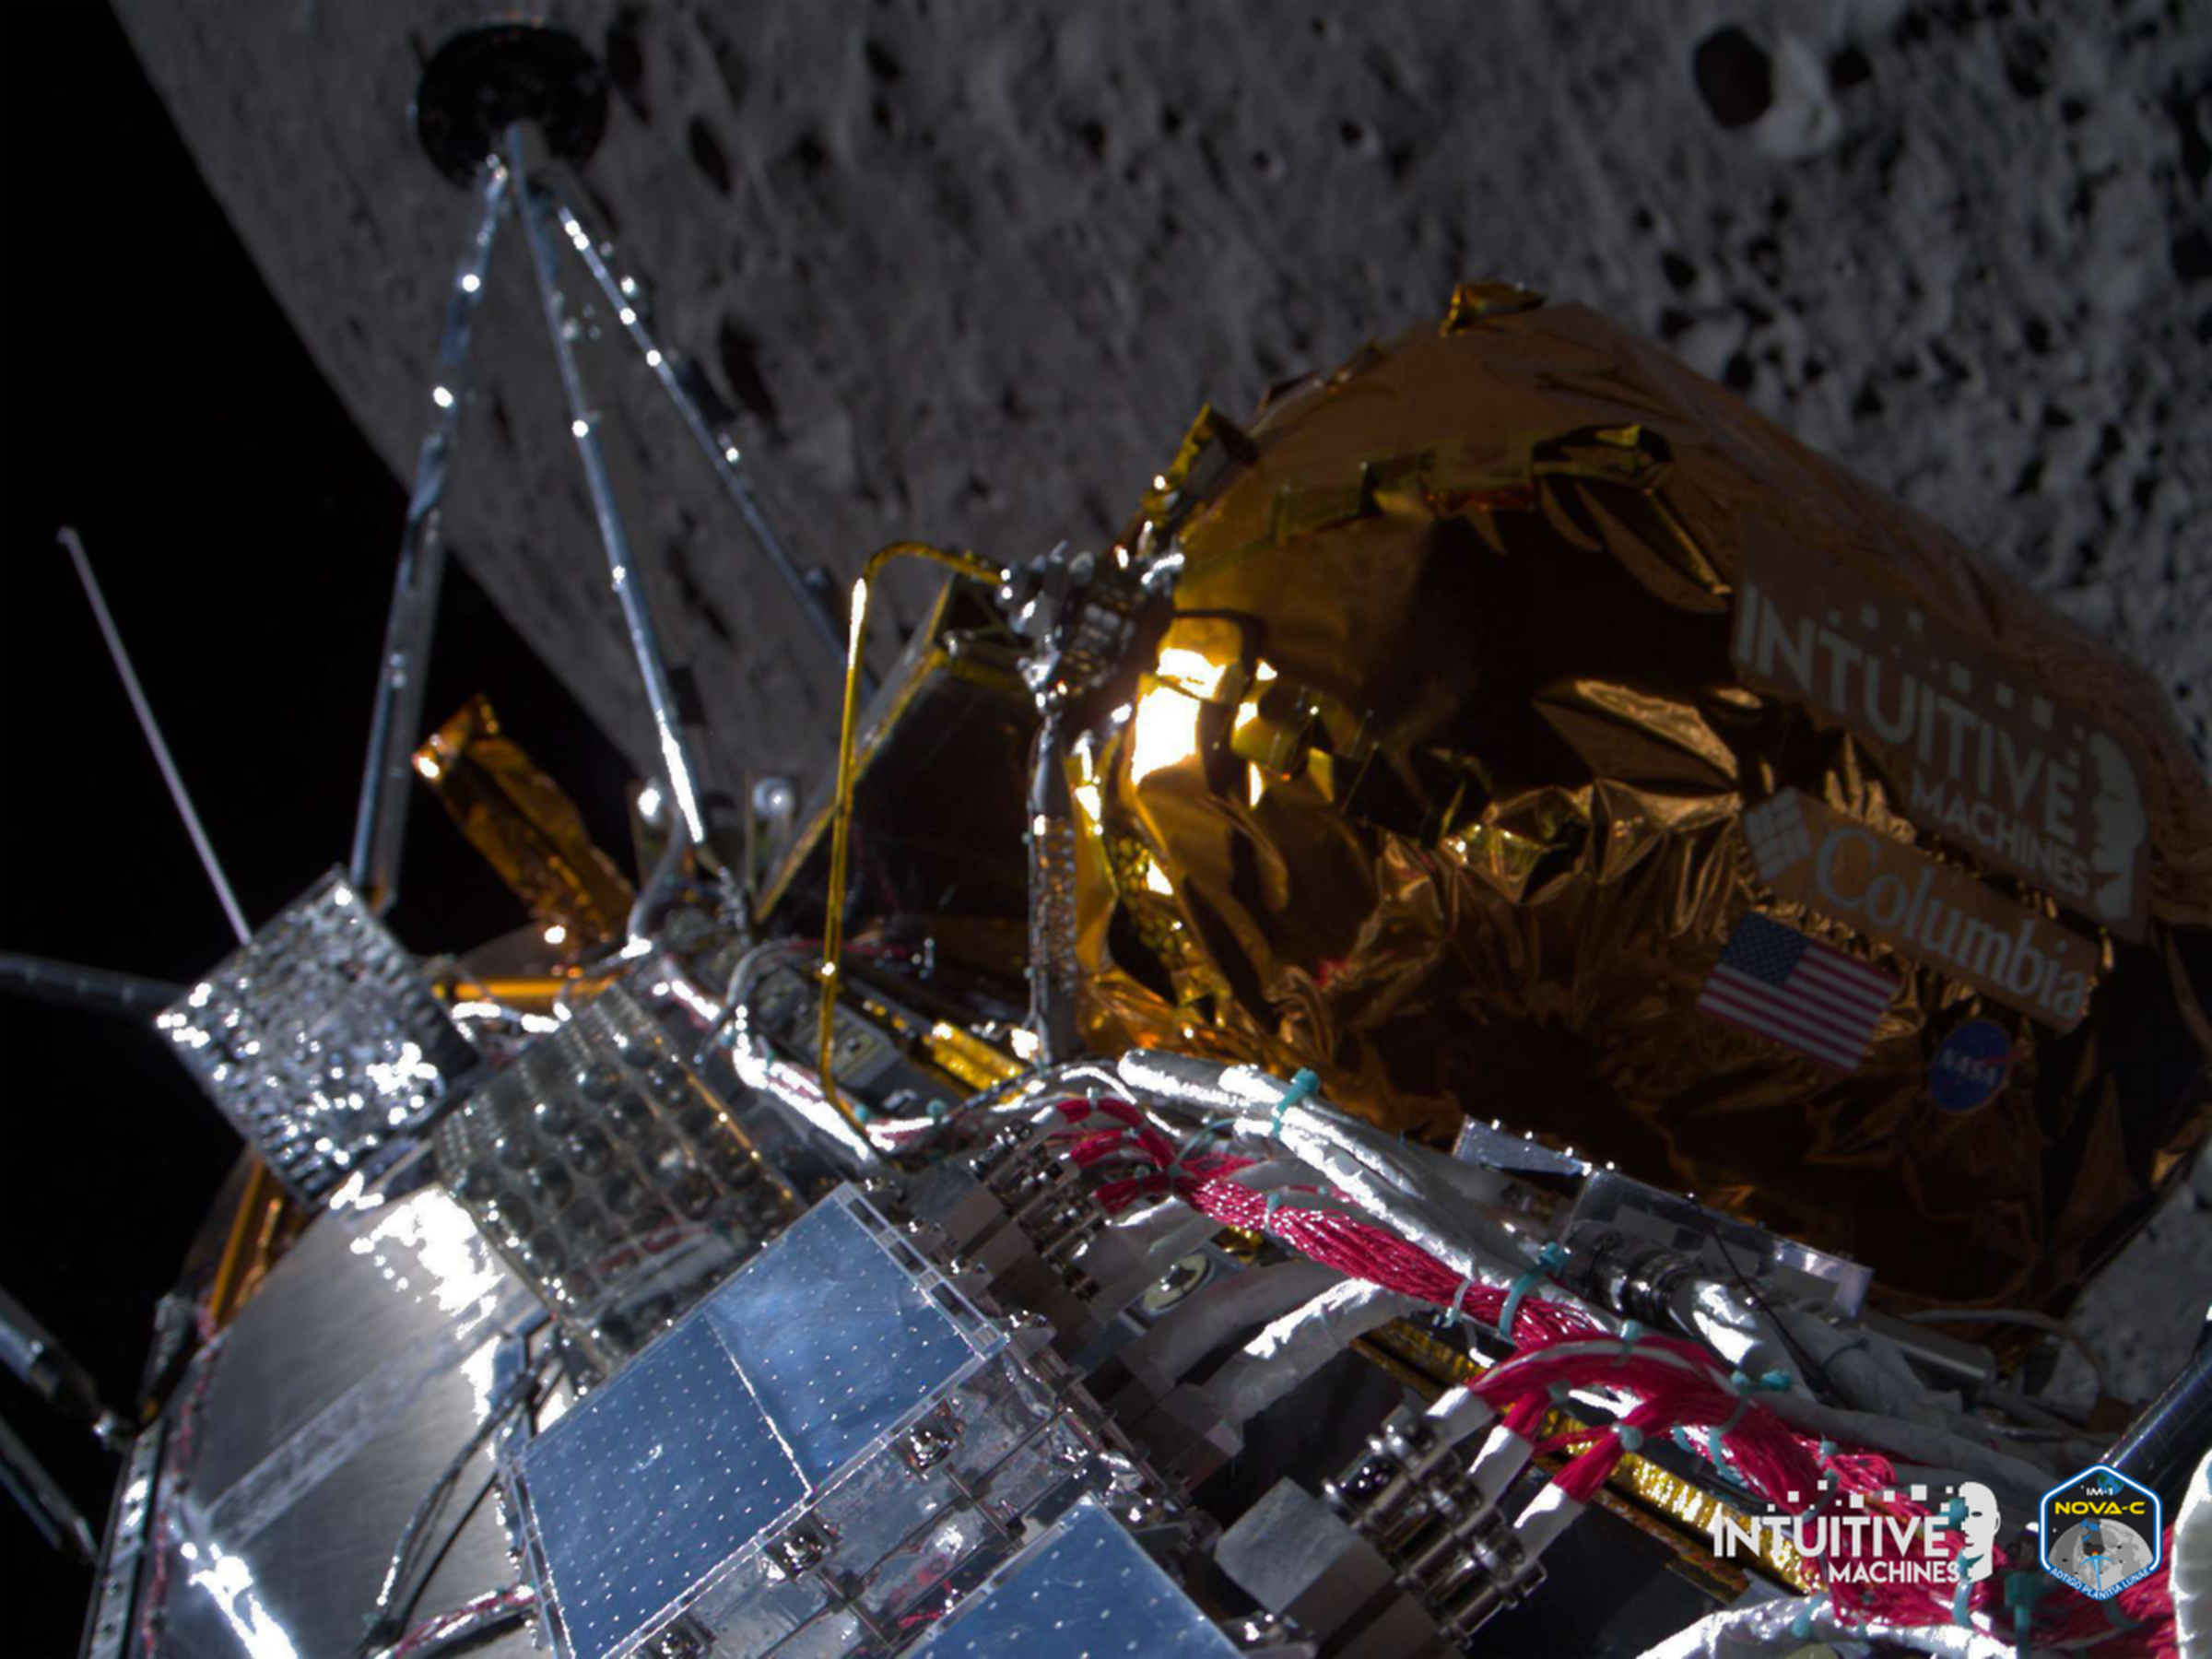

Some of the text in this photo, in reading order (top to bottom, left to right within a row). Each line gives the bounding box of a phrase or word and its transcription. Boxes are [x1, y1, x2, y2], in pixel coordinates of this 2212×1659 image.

[1735, 583, 2079, 845] INTUITIVE
[1911, 766, 2089, 898] MACHINES
[1815, 828, 2089, 1019] Columbia
[1938, 1047, 1998, 1088] NASA
